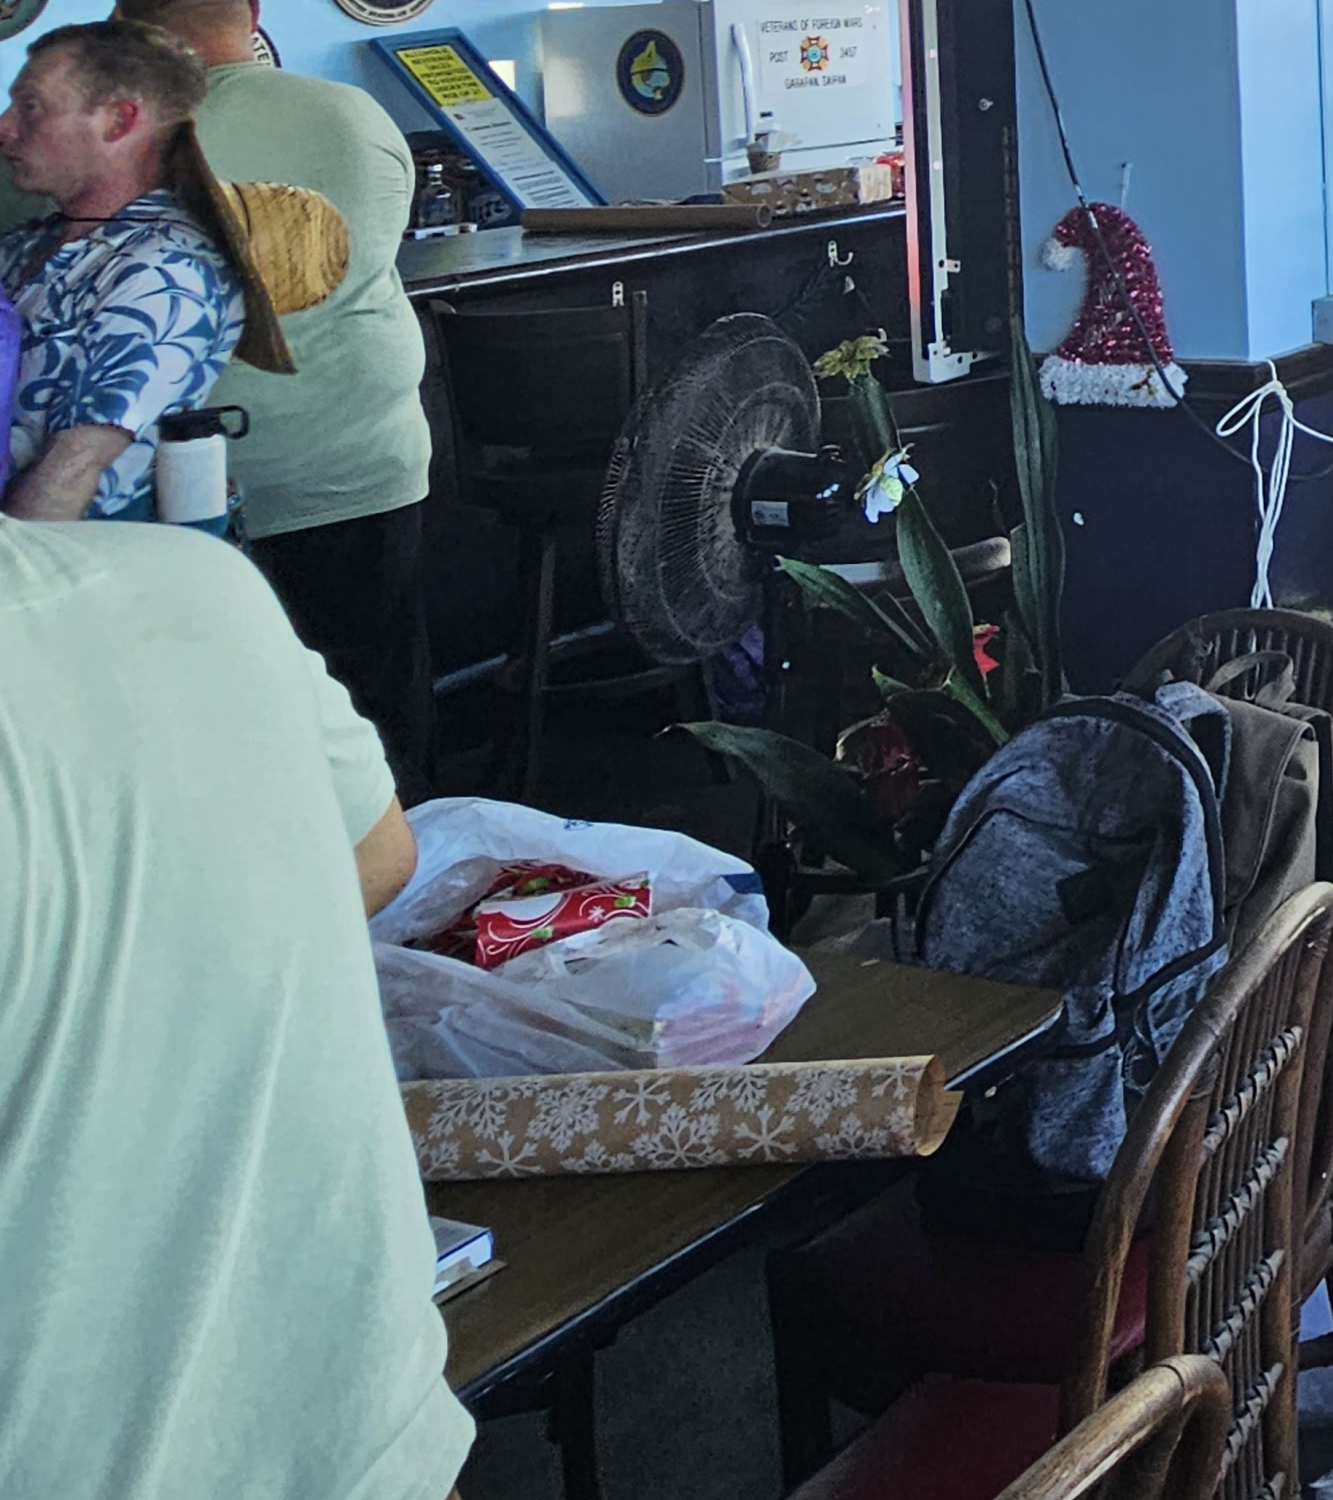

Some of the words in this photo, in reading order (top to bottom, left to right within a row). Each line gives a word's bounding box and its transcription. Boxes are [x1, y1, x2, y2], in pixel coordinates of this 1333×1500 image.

[761, 20, 798, 33] VETERANS
[800, 19, 809, 31] OF
[812, 18, 841, 30] FOREIGN
[843, 17, 863, 28] WARS
[769, 50, 788, 63] POST
[822, 74, 846, 87] SAIPAN
